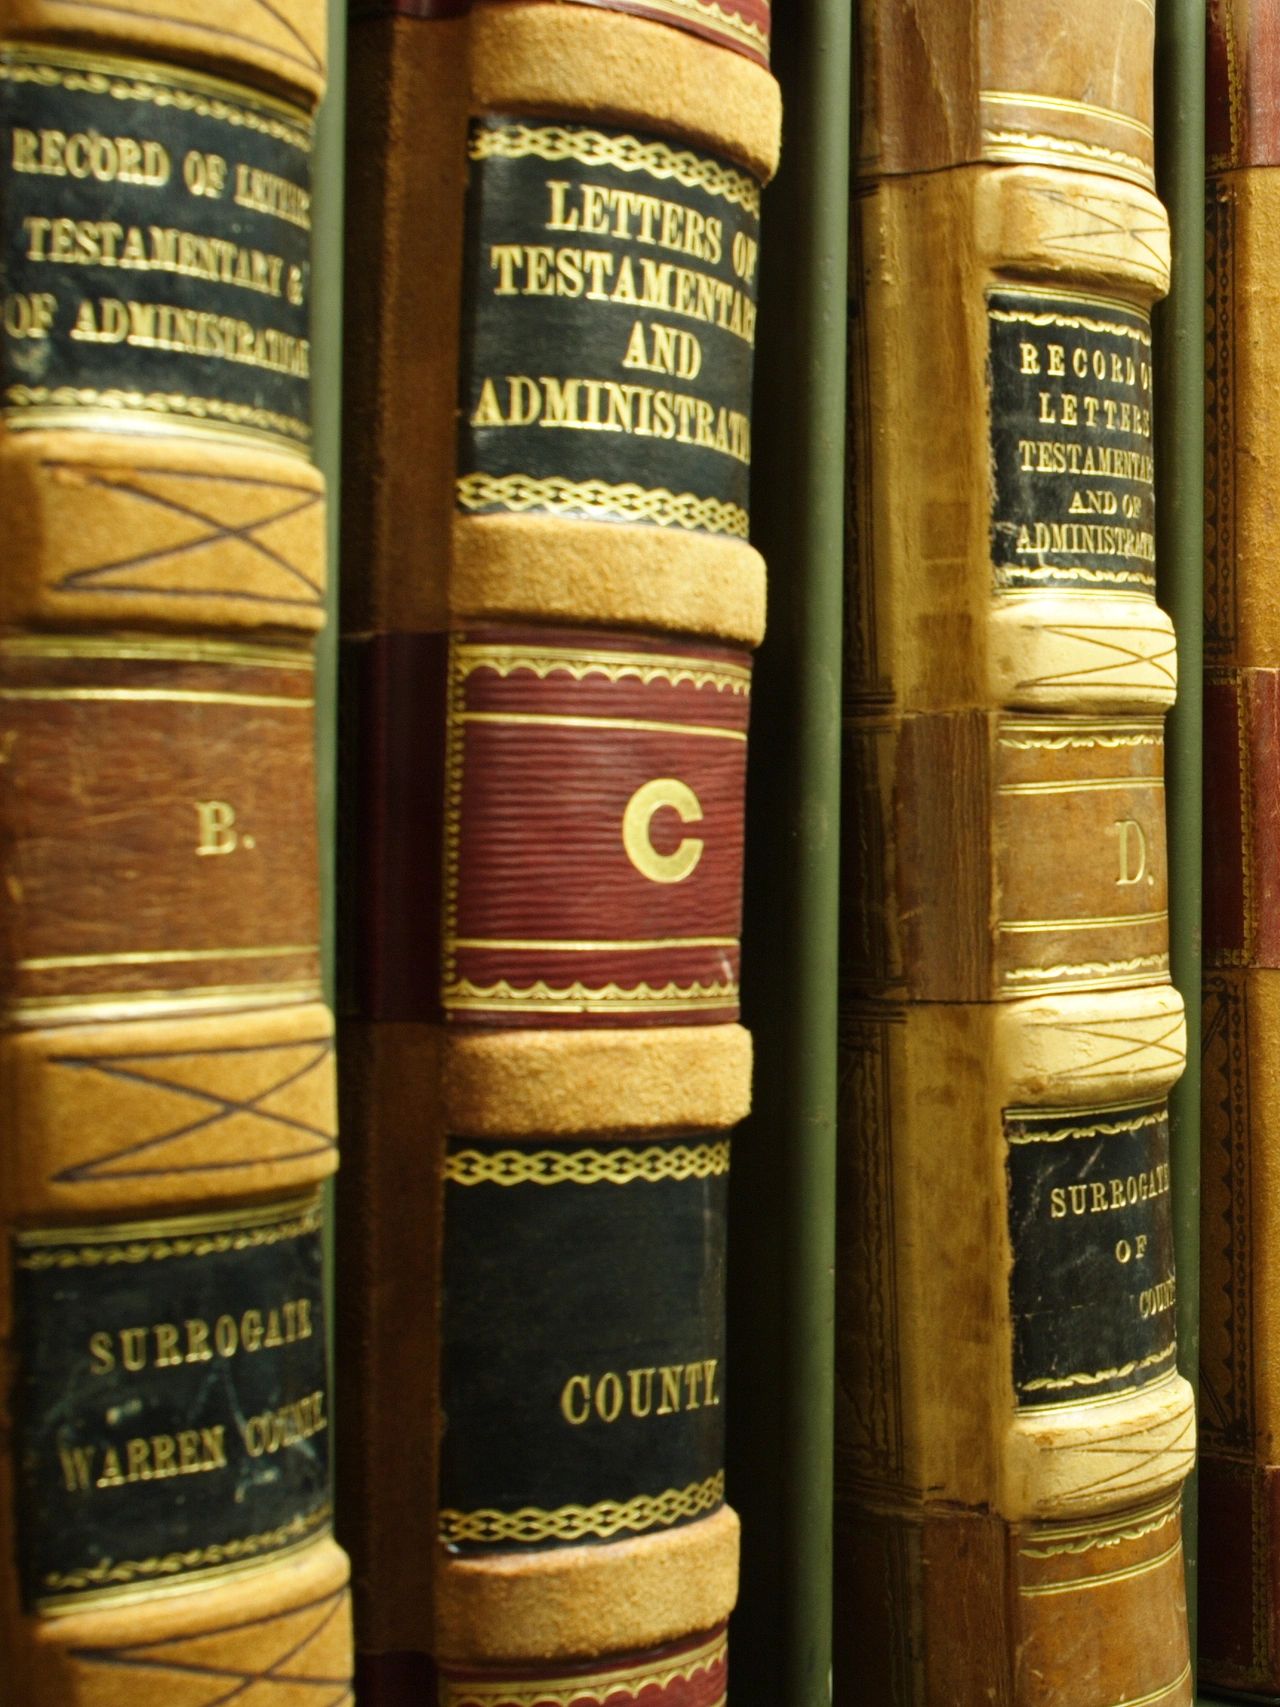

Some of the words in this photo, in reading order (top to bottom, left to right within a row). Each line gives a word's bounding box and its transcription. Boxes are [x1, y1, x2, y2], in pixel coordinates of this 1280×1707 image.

[11, 127, 172, 188] RECORD
[183, 150, 227, 199] OF
[545, 180, 723, 264] LETTERS
[23, 216, 284, 297] TESTAMENTARY
[286, 264, 304, 306] &
[4, 292, 58, 340] OF
[622, 321, 702, 381] AND
[1019, 342, 1136, 386] RECORD
[1038, 391, 1151, 438] LETTERS
[1068, 490, 1117, 515] AND
[1122, 494, 1144, 519] OF
[195, 801, 256, 856] B.
[622, 777, 704, 884] C
[1113, 819, 1155, 886] D.
[1115, 1234, 1149, 1264] OF
[59, 1425, 229, 1492] WARREN
